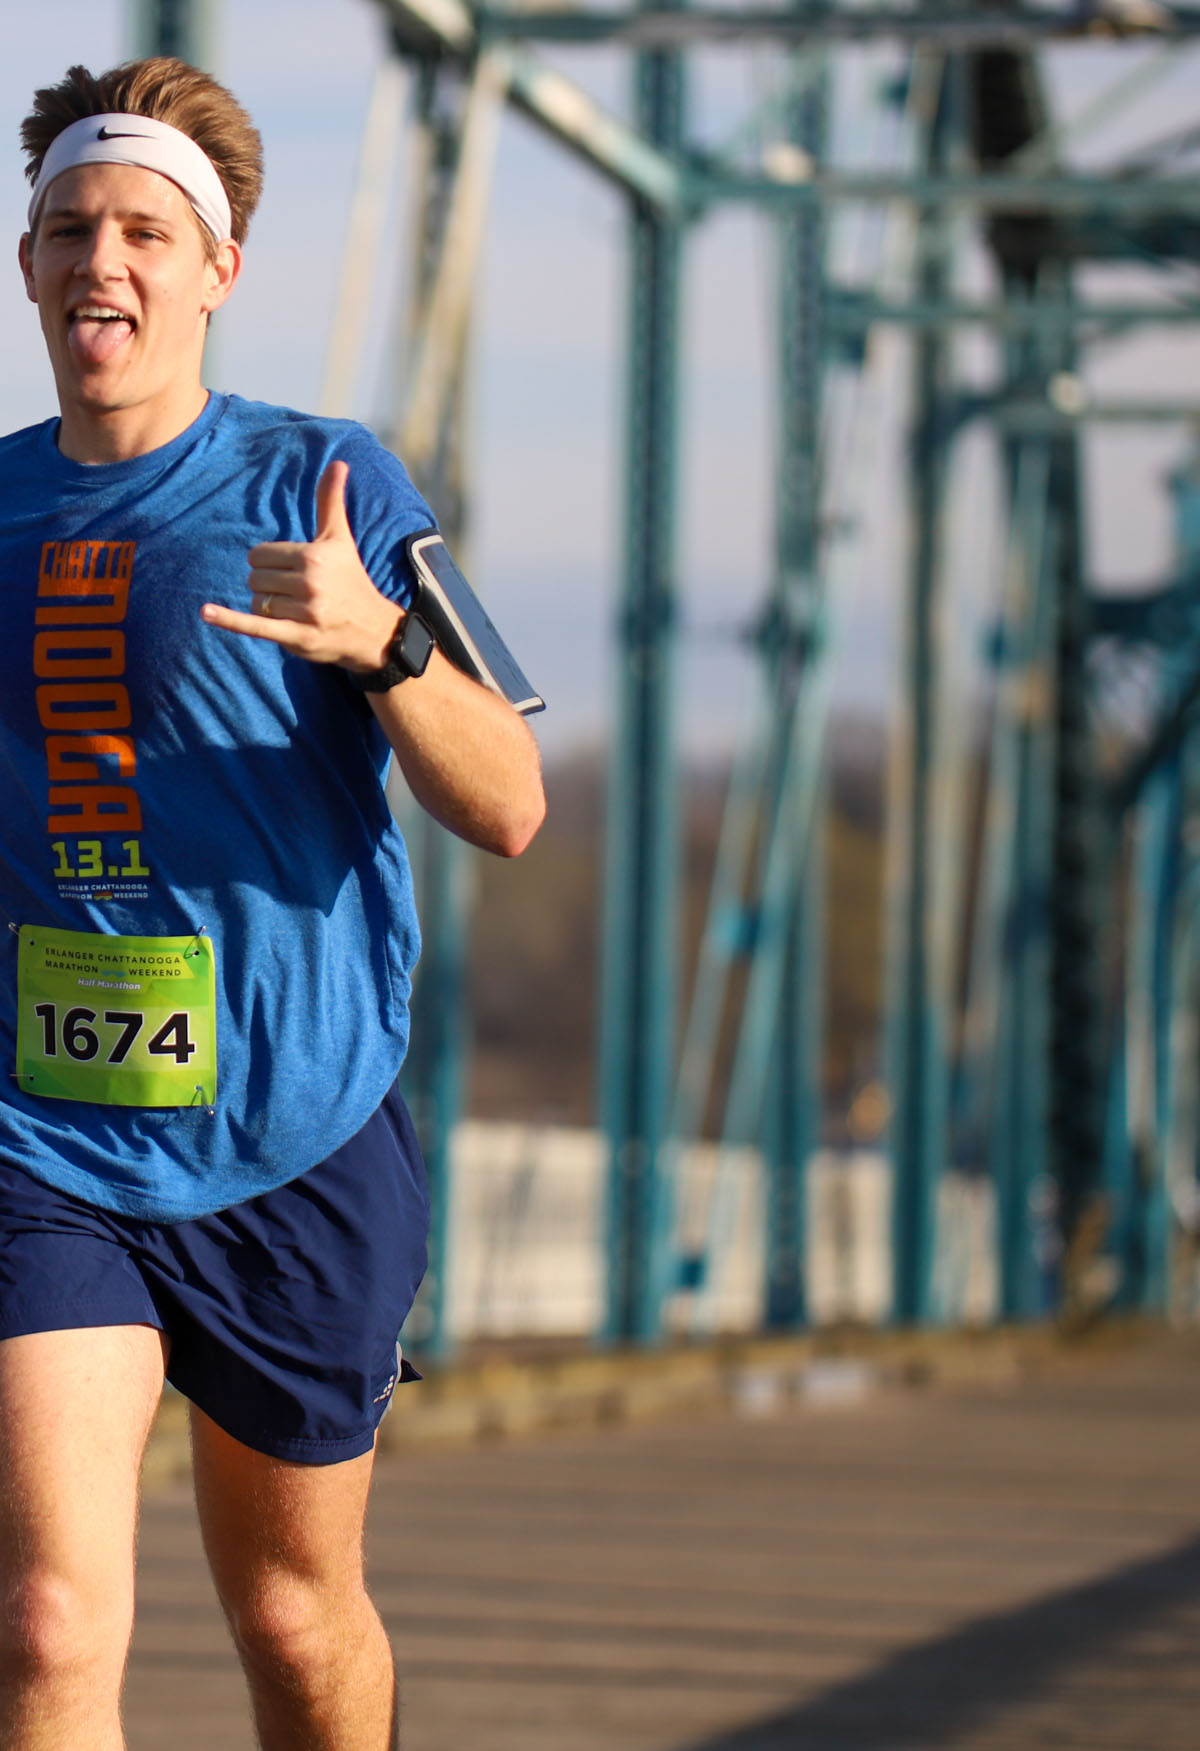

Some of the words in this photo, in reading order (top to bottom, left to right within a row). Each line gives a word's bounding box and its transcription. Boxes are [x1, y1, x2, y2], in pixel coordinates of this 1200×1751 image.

[39, 540, 137, 579] CHATTA
[51, 839, 150, 877] 13.1
[90, 883, 148, 891] CHATTANOOGA
[45, 947, 94, 961] ERLANGER
[97, 954, 181, 965] CHATTANOOGA
[45, 959, 99, 974] MARATHON
[128, 968, 182, 977] WEEKEND
[77, 977, 96, 987] Half
[97, 980, 141, 991] Marathon
[34, 1002, 196, 1065] 1674
